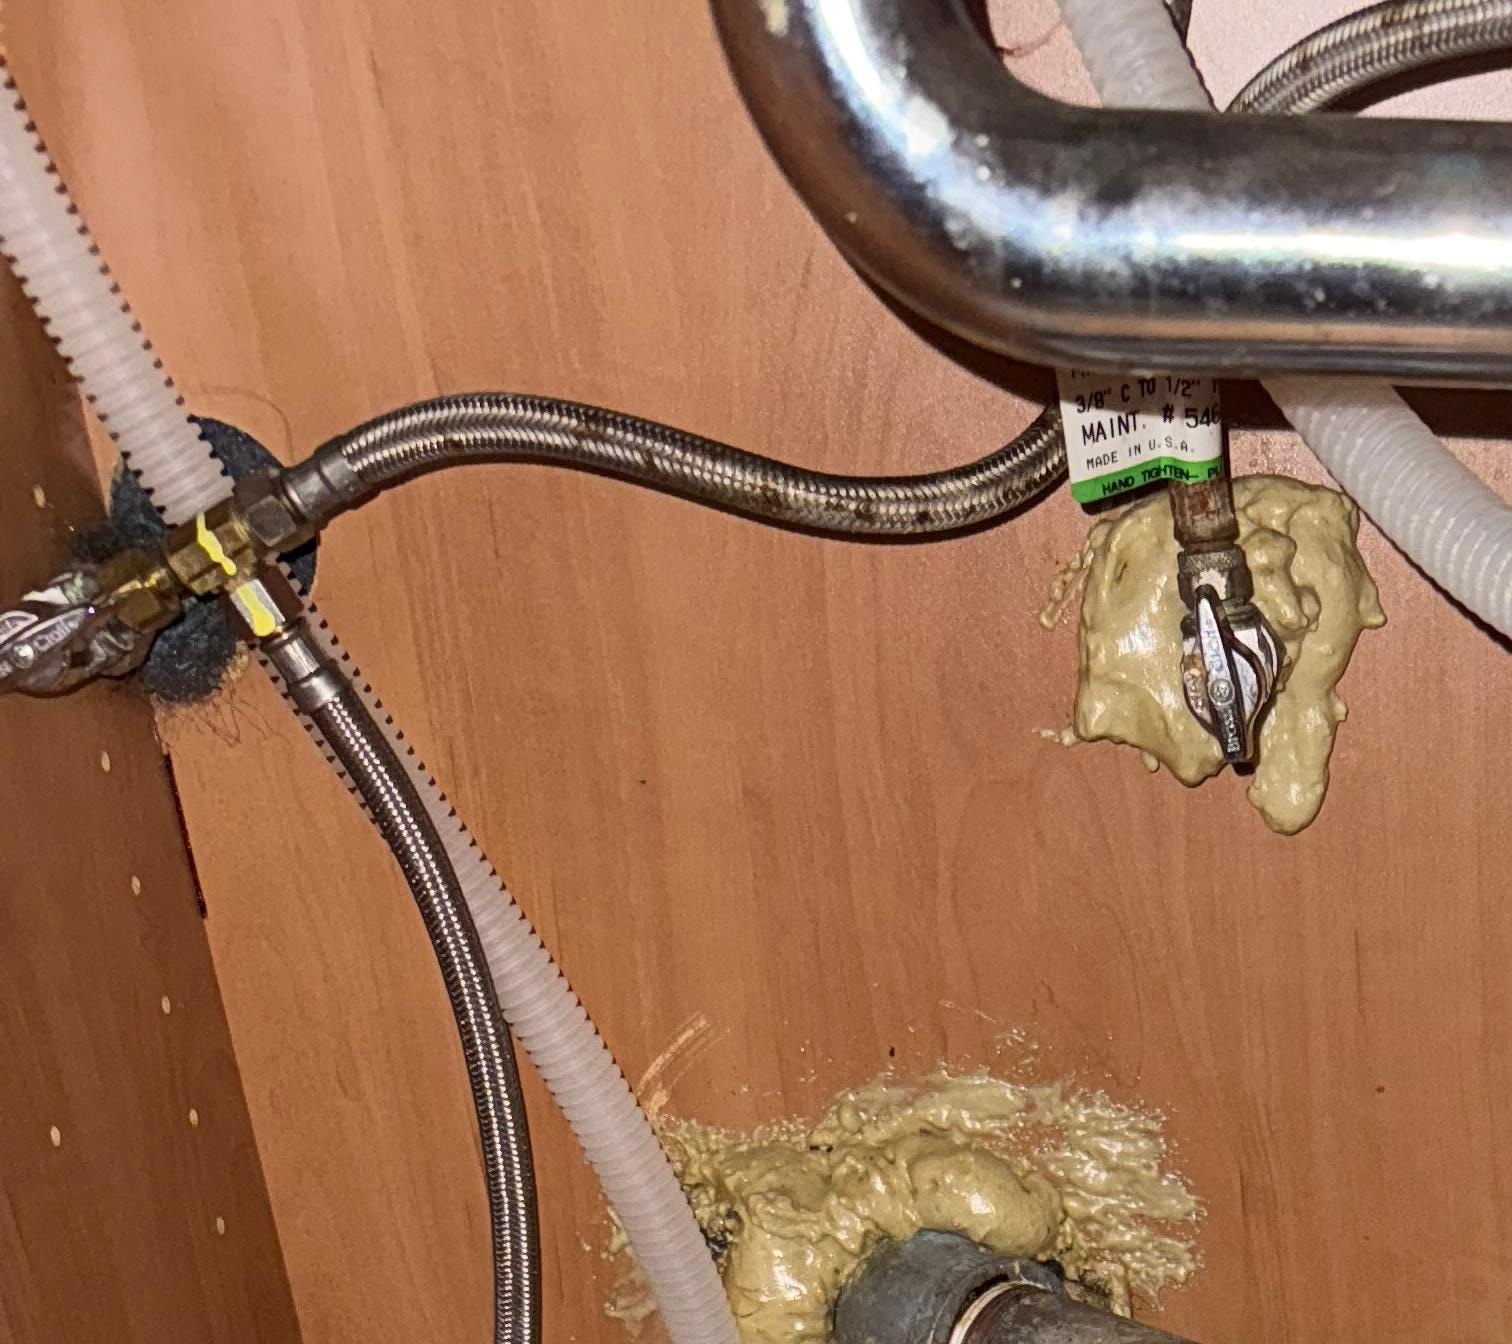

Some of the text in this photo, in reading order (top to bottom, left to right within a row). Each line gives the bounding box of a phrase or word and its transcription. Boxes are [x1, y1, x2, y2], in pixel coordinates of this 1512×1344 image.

[1082, 411, 1146, 446] MAINT.
[1086, 436, 1195, 470] MADE IN U.S.A.
[1103, 475, 1135, 496] HAND
